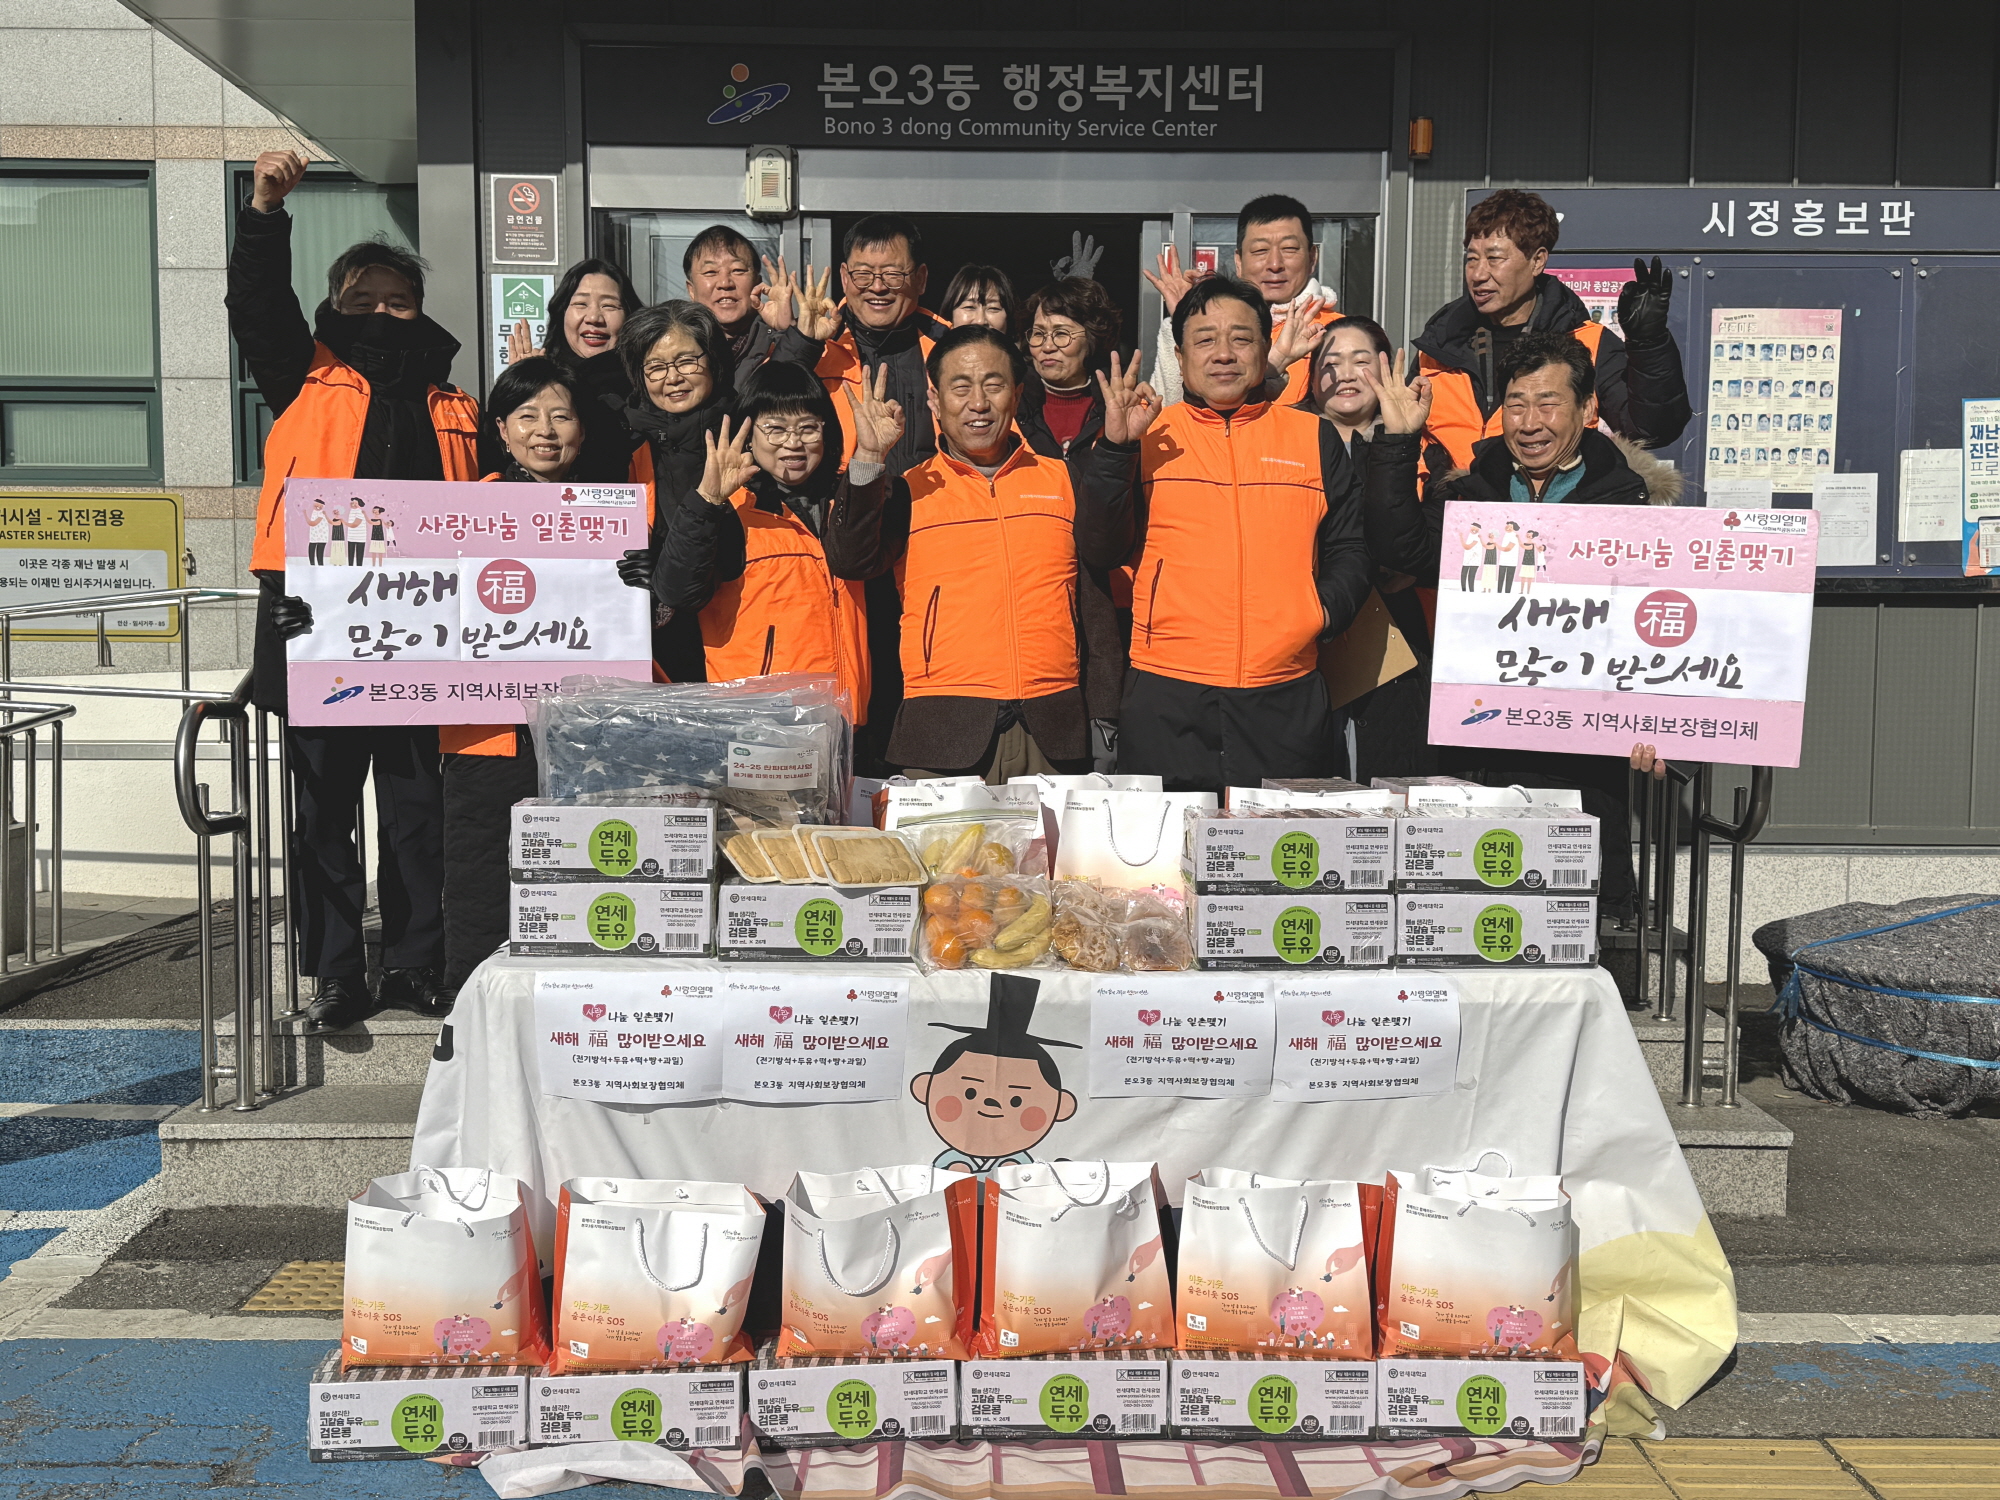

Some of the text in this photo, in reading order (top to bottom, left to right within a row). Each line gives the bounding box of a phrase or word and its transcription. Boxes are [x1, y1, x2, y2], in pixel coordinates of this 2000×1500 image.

[817, 62, 1265, 112] 본오3동 행정복지센터
[824, 117, 1217, 140] Bono 3 dong Community Service Center
[1702, 198, 1915, 238] 시정홍보판
[1970, 424, 2000, 440] 재난
[1970, 442, 2000, 459] 진단
[1970, 462, 2000, 476] 프로
[580, 487, 636, 500] 사랑의열매
[57, 508, 125, 527] 지진겸용
[1744, 512, 1808, 528] 사랑의열매
[38, 530, 91, 542] SHELTER)
[417, 512, 630, 543] 사랑나눔 일촌맺기
[1568, 538, 1795, 572] 사랑나눔 일촌맺기
[19, 558, 129, 570] 이곳은 각종 재난 발생 시
[0, 577, 156, 590] 용되는 이재민 임시주거시설입니다.
[348, 570, 458, 606] 새해
[482, 570, 526, 604] 福
[1498, 596, 1610, 634] 새해
[1640, 600, 1688, 638] 福
[348, 616, 592, 660] 많이 받으세요
[1496, 646, 1744, 692] 많이 받으세요
[368, 682, 438, 702] 본오3동
[1504, 706, 1758, 741] 본오3동 지역사회보장협의체
[734, 762, 762, 770] 24-25
[521, 838, 562, 847] 고칼슘 두유
[598, 830, 632, 847] 연세
[521, 848, 551, 859] 검은콩
[598, 849, 632, 866] 두유
[1281, 843, 1314, 859] 연세
[1481, 841, 1514, 858] 연세
[1281, 862, 1314, 879] 두유
[1405, 860, 1434, 870] 검은콩
[1482, 860, 1514, 878] 두유
[595, 905, 628, 922] 연세
[804, 910, 836, 926] 연세
[595, 923, 628, 941] 두유
[1281, 918, 1314, 935] 연세
[1481, 916, 1514, 933] 연세
[804, 928, 836, 946] 두유
[1481, 935, 1514, 952] 두유
[1281, 938, 1314, 954] 두유
[586, 1008, 674, 1023] 사랑 나눔 일촌맺기
[772, 1010, 859, 1026] 사랑 나눔 일촌맺기
[1142, 1012, 1226, 1028] 사랑 나눔 일촌맺기
[1325, 1013, 1411, 1027] 사랑 나눔 일촌맺기
[550, 1030, 706, 1048] 새해 福 많이받으세요
[734, 1032, 889, 1050] 새해 福 많이받으세요
[1104, 1033, 1258, 1051] 새해 福 많이받으세요
[1288, 1034, 1442, 1051] 새해 福 많이받으세요
[572, 1078, 684, 1090] 본오3동 지역사회보장협의체
[754, 1080, 866, 1090] 본오3동 지역사회보장협의체
[1124, 1076, 1234, 1087] 본오3동 지역사회보장협의체
[1309, 1077, 1419, 1089] 본오3동 지역사회보장협의체
[1221, 1292, 1239, 1300] SOS
[1034, 1306, 1052, 1315] SOS
[1436, 1300, 1454, 1310] SOS
[383, 1313, 402, 1322] SOS
[606, 1316, 625, 1326] SOS
[812, 1312, 829, 1321] SOS
[836, 1391, 870, 1409] 연세
[1049, 1385, 1082, 1402] 연세
[1258, 1386, 1290, 1404] 연세
[1466, 1386, 1500, 1404] 연세
[402, 1405, 436, 1422] 연세
[621, 1400, 654, 1417] 연세
[1049, 1404, 1083, 1422] 두유
[1258, 1405, 1291, 1424] 두유
[1467, 1406, 1500, 1424] 두유
[837, 1410, 871, 1429] 두유
[402, 1424, 437, 1443] 두유
[621, 1419, 655, 1438] 두유
